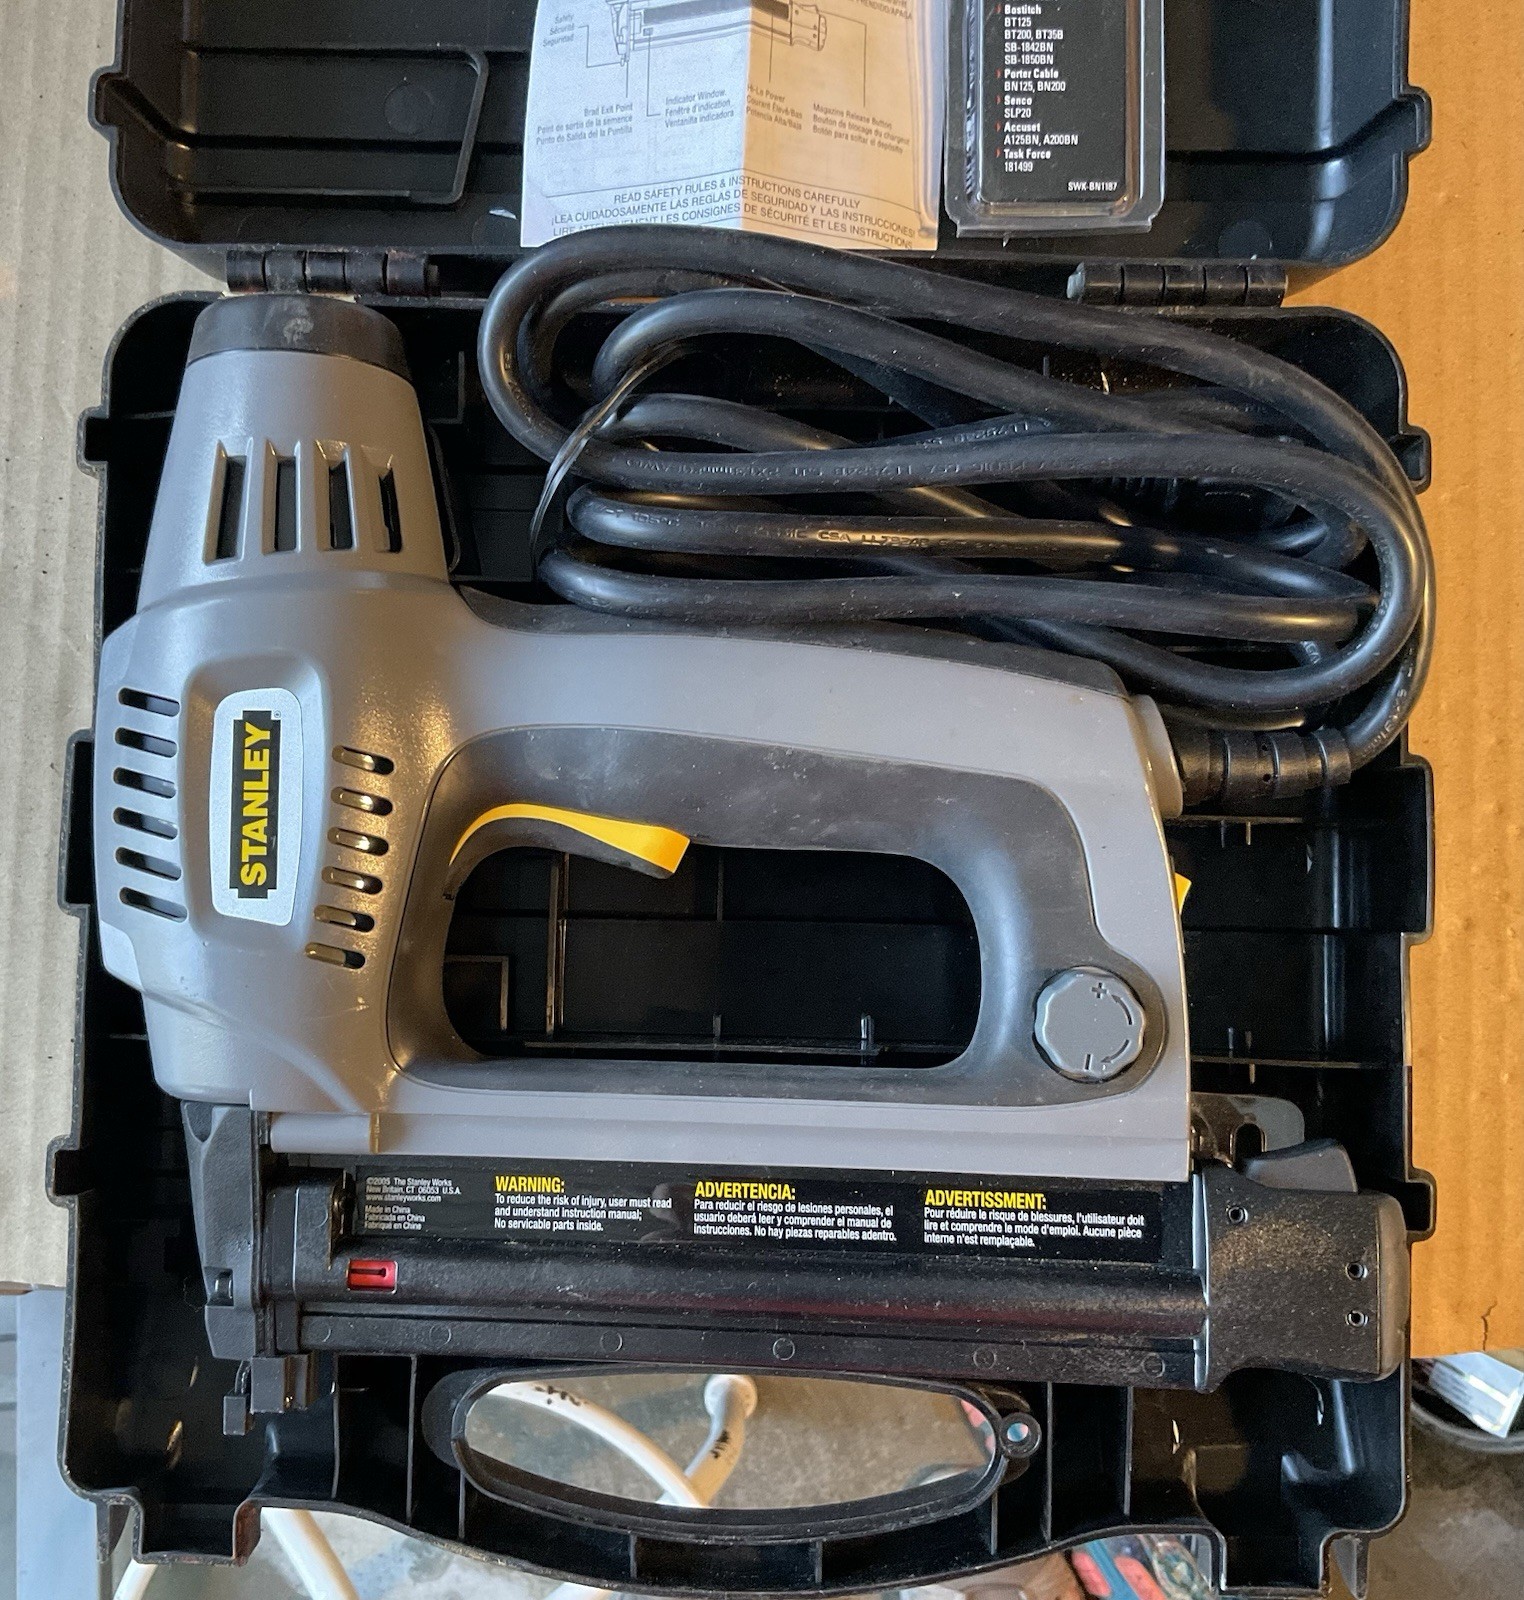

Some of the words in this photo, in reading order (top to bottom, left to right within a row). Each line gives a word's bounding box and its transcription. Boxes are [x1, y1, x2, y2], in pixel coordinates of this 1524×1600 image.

[1004, 5, 1041, 15] Bostitch
[1004, 18, 1031, 27] BT125
[1004, 30, 1033, 40] BT200,
[1036, 30, 1063, 39] BT35B
[1004, 43, 1053, 52] SB-1842BN
[1004, 55, 1054, 64] SB-1850BN
[1004, 69, 1031, 78] Porter
[1033, 69, 1058, 78] Cable
[1004, 82, 1035, 93] BN125,
[1037, 82, 1065, 91] BN200
[1004, 96, 1032, 105] Senco
[1004, 109, 1031, 118] SLP20
[1004, 123, 1040, 132] Accuset
[1004, 135, 1041, 146] A125BN,
[1043, 135, 1078, 145] A200BN
[1004, 149, 1024, 158] Task
[1026, 149, 1051, 158] Force
[1004, 162, 1033, 172] 181499
[614, 193, 642, 204] READ
[644, 186, 682, 200] SAFETY
[685, 180, 716, 194] RULES
[720, 178, 726, 188] &
[729, 176, 801, 198] INSTRUCTIONS
[804, 191, 861, 208] CAREFULLY
[1068, 182, 1117, 191] SWK-BN1187
[575, 203, 666, 222] CUIDADOSAMENTE
[670, 198, 688, 210] LAS
[692, 190, 730, 206] REGLAS
[734, 189, 748, 198] DE
[751, 192, 807, 213] SEGURIDAD
[810, 204, 816, 214] Y
[820, 207, 840, 218] LAS
[680, 202, 740, 221] CONSIGNES
[744, 204, 757, 215] DE
[760, 206, 810, 226] SÉCURITÉ
[813, 218, 824, 228] ET
[828, 221, 847, 233] LES
[850, 226, 912, 250] INSTRUCTIONS
[818, 530, 850, 543] CSA
[240, 722, 270, 886] STANLEY
[407, 1178, 430, 1186] Stanley
[496, 1176, 564, 1193] WARNING:
[695, 1182, 796, 1200] ADVERTENCIA:
[495, 1194, 505, 1203] To
[507, 1194, 535, 1204] reduce
[538, 1195, 551, 1205] the
[554, 1196, 568, 1205] risk
[571, 1196, 580, 1206] of
[582, 1197, 606, 1208] injury,
[629, 1198, 651, 1207] must
[653, 1198, 672, 1208] read
[925, 1189, 1046, 1210] ADVERTISSMENT:
[495, 1207, 510, 1216] and
[513, 1207, 560, 1217] understand
[562, 1209, 606, 1218] instruction
[608, 1210, 642, 1221] manual;
[694, 1199, 713, 1210] Para
[716, 1200, 745, 1211] reducir
[748, 1201, 755, 1211] el
[757, 1202, 783, 1214] riesgo
[785, 1202, 795, 1212] de
[798, 1203, 832, 1214] lesiones
[835, 1204, 883, 1217] personales,
[886, 1206, 893, 1216] el
[694, 1212, 725, 1223] usuario
[727, 1212, 756, 1224] deberá
[759, 1213, 774, 1224] leer
[776, 1217, 782, 1227] y
[784, 1215, 835, 1228] comprender
[837, 1216, 845, 1227] el
[847, 1217, 878, 1228] manual
[881, 1218, 892, 1228] de
[924, 1208, 944, 1218] Pour
[946, 1208, 976, 1220] réduire
[979, 1210, 986, 1220] le
[989, 1210, 1016, 1223] risque
[1018, 1211, 1029, 1221] de
[1031, 1212, 1074, 1225] blessures,
[1076, 1213, 1125, 1226] l'utilisateur
[1127, 1214, 1144, 1226] doit
[495, 1219, 506, 1228] No
[508, 1219, 550, 1229] servicable
[553, 1220, 574, 1231] parts
[576, 1221, 603, 1231] inside.
[924, 1220, 938, 1230] lire
[940, 1221, 949, 1231] et
[951, 1222, 1002, 1235] comprendre
[1004, 1223, 1012, 1233] le
[1015, 1224, 1039, 1235] mode
[1041, 1224, 1081, 1238] d'emploi.
[1083, 1226, 1116, 1238] Aucune
[1118, 1226, 1142, 1240] pièce
[694, 1223, 752, 1236] instrucciones.
[754, 1226, 766, 1236] No
[768, 1227, 783, 1239] hay
[785, 1227, 812, 1240] piezas
[815, 1228, 859, 1241] reparables
[862, 1230, 897, 1241] adentro.
[957, 1234, 978, 1245] n'est
[980, 1235, 1035, 1248] remplaçable.
